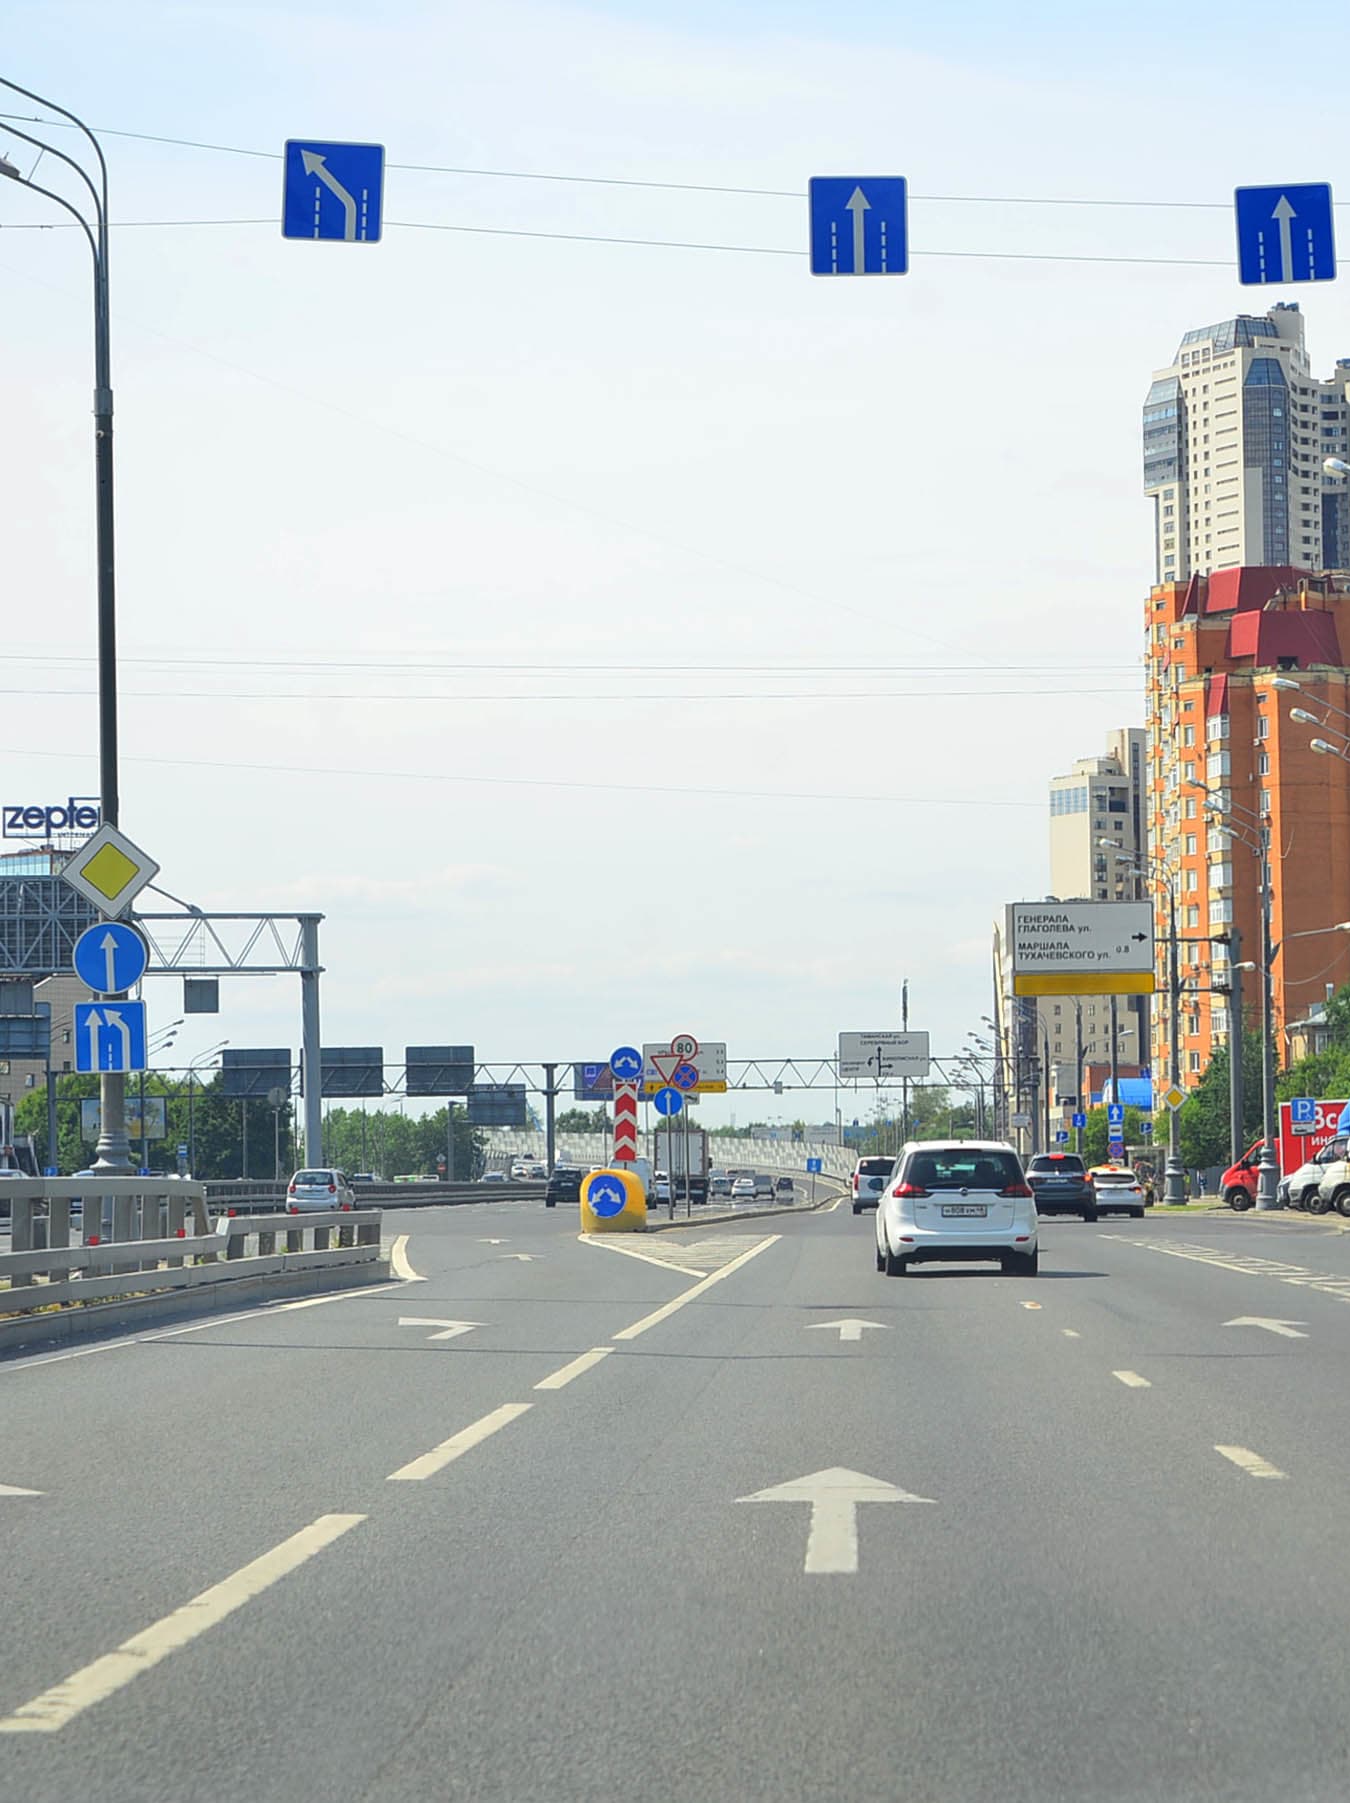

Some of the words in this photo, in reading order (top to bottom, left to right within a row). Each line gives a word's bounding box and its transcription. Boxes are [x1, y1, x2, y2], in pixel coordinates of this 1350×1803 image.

[1017, 914, 1069, 924] ГЕНЕРАЛА
[1017, 924, 1076, 933] ГЛАГОЛЕВА
[1018, 942, 1070, 951] МАРШАЛА
[1018, 951, 1096, 960] ТУХАЧЕВСКОГО
[677, 1042, 693, 1053] 80
